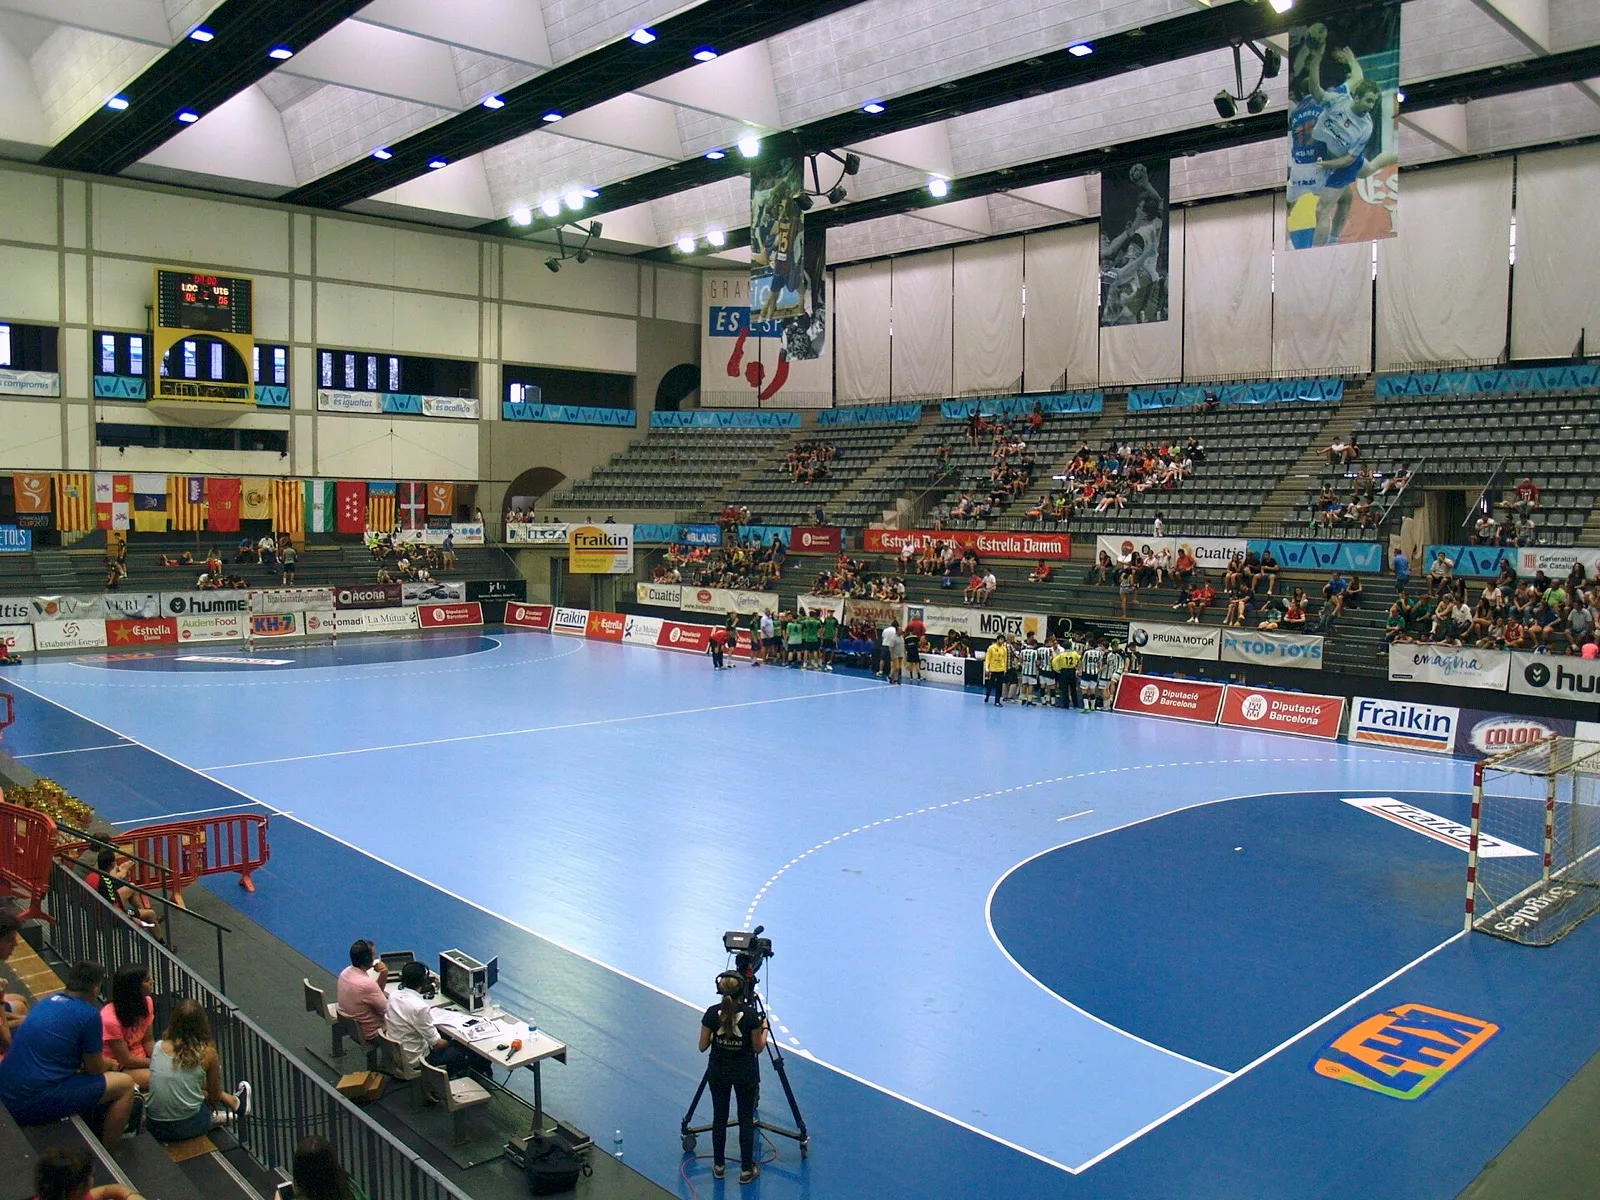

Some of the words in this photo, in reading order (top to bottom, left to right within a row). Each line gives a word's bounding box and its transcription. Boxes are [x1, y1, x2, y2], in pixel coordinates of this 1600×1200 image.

[716, 307, 740, 331] ÉS
[343, 398, 373, 408] igualtat
[444, 403, 471, 413] acollida
[528, 530, 567, 539] ILCA
[574, 533, 629, 546] Fraikin
[977, 535, 1021, 552] Estrella
[1024, 538, 1062, 553] Damm
[1195, 546, 1244, 562] Cualtis
[1539, 555, 1578, 564] Generalitat
[1549, 563, 1574, 571] Catalu
[352, 589, 385, 601] ÀGORA
[648, 588, 680, 602] Cualtis
[106, 600, 139, 611] VERI
[254, 616, 293, 632] KH-7
[322, 617, 363, 626] euomadi
[555, 609, 586, 625] Fraikin
[601, 618, 622, 630] Estrella
[132, 625, 171, 636] Estrella
[40, 638, 78, 648] Estabanell
[1153, 634, 1181, 643] PRUNA
[1183, 636, 1214, 646] MOTOR
[1242, 640, 1275, 656] TOP
[1279, 644, 1321, 659] TOYS
[919, 657, 963, 676] Cualtis
[1065, 656, 1074, 666] 12
[1555, 665, 1600, 693] hu
[1162, 688, 1199, 702] Diputació
[1160, 696, 1197, 710] Barcelona
[1271, 699, 1321, 716] Diputació
[1269, 711, 1319, 726] Barcelona
[1357, 701, 1452, 733] Fraikin
[1380, 803, 1501, 848] Fraikin
[1325, 1008, 1486, 1092] KH-7
